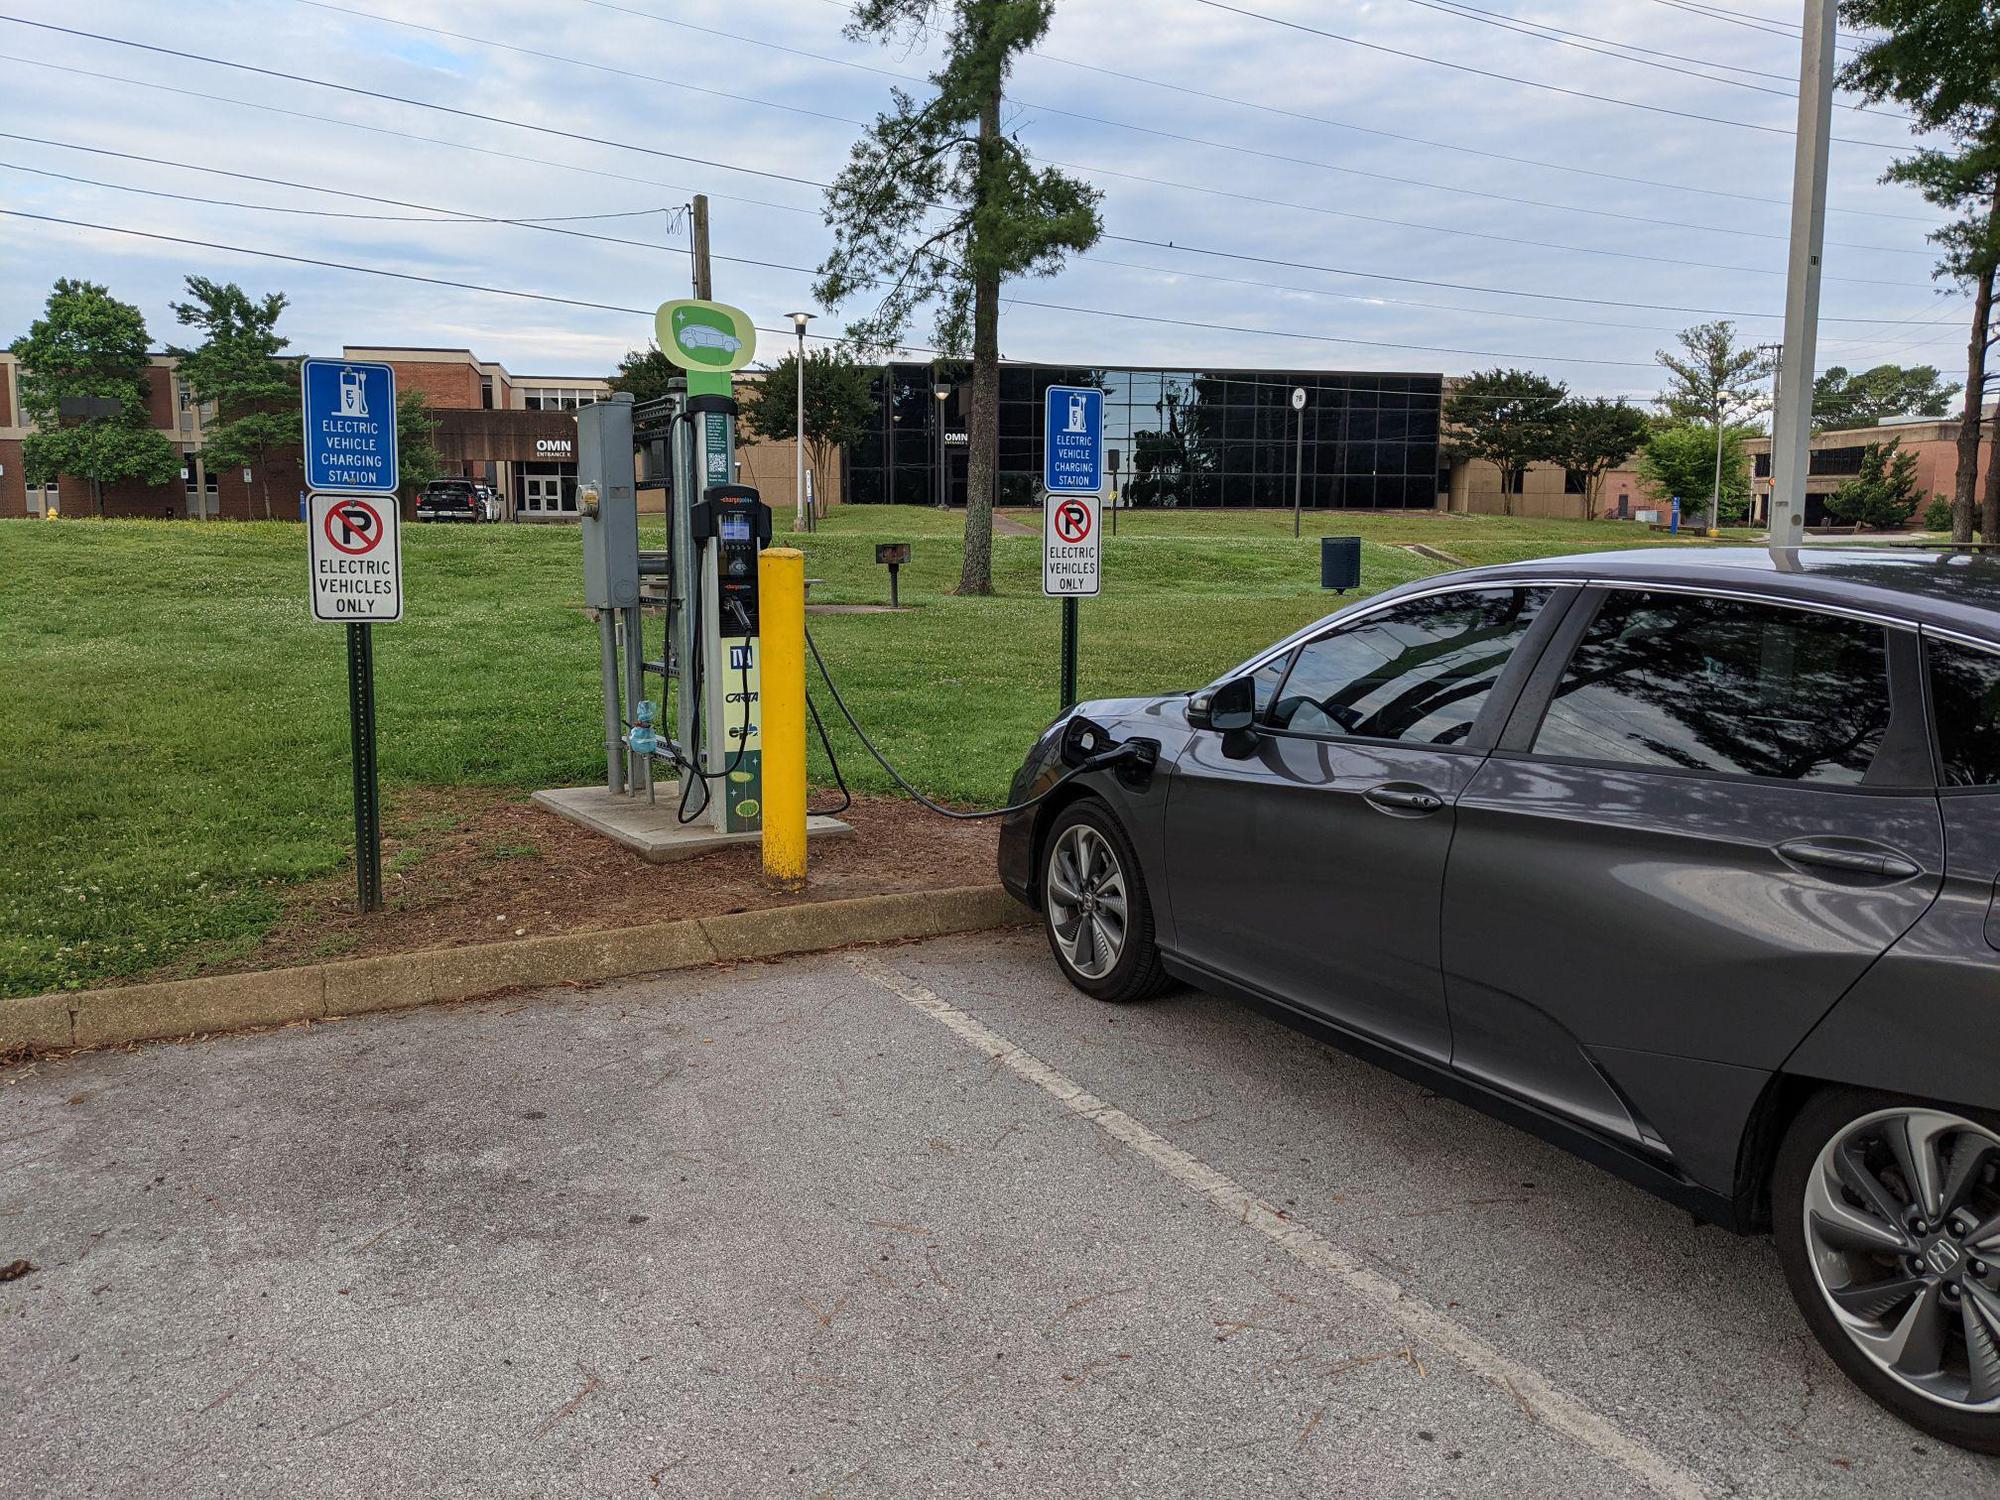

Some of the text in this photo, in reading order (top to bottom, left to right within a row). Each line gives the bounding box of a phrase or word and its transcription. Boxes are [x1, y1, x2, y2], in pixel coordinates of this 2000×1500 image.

[322, 419, 379, 435] ELECTRIC
[945, 433, 968, 441] OMN
[1056, 435, 1092, 446] ELECTRIC
[326, 437, 377, 451] VEHICLE
[536, 440, 571, 451] OMN
[321, 453, 382, 467] CHARGING
[1058, 448, 1090, 460] VEHICLE
[1054, 461, 1093, 473] CHARGING
[328, 470, 377, 483] STATION
[1058, 475, 1090, 486] STATION
[1050, 546, 1095, 559] ELECTRIC
[319, 559, 391, 575] ELECTRIC
[1049, 562, 1095, 575] VEHICLES
[319, 578, 392, 594] VEHICLES
[1059, 577, 1085, 590] ONLY
[336, 598, 375, 613] ONLY
